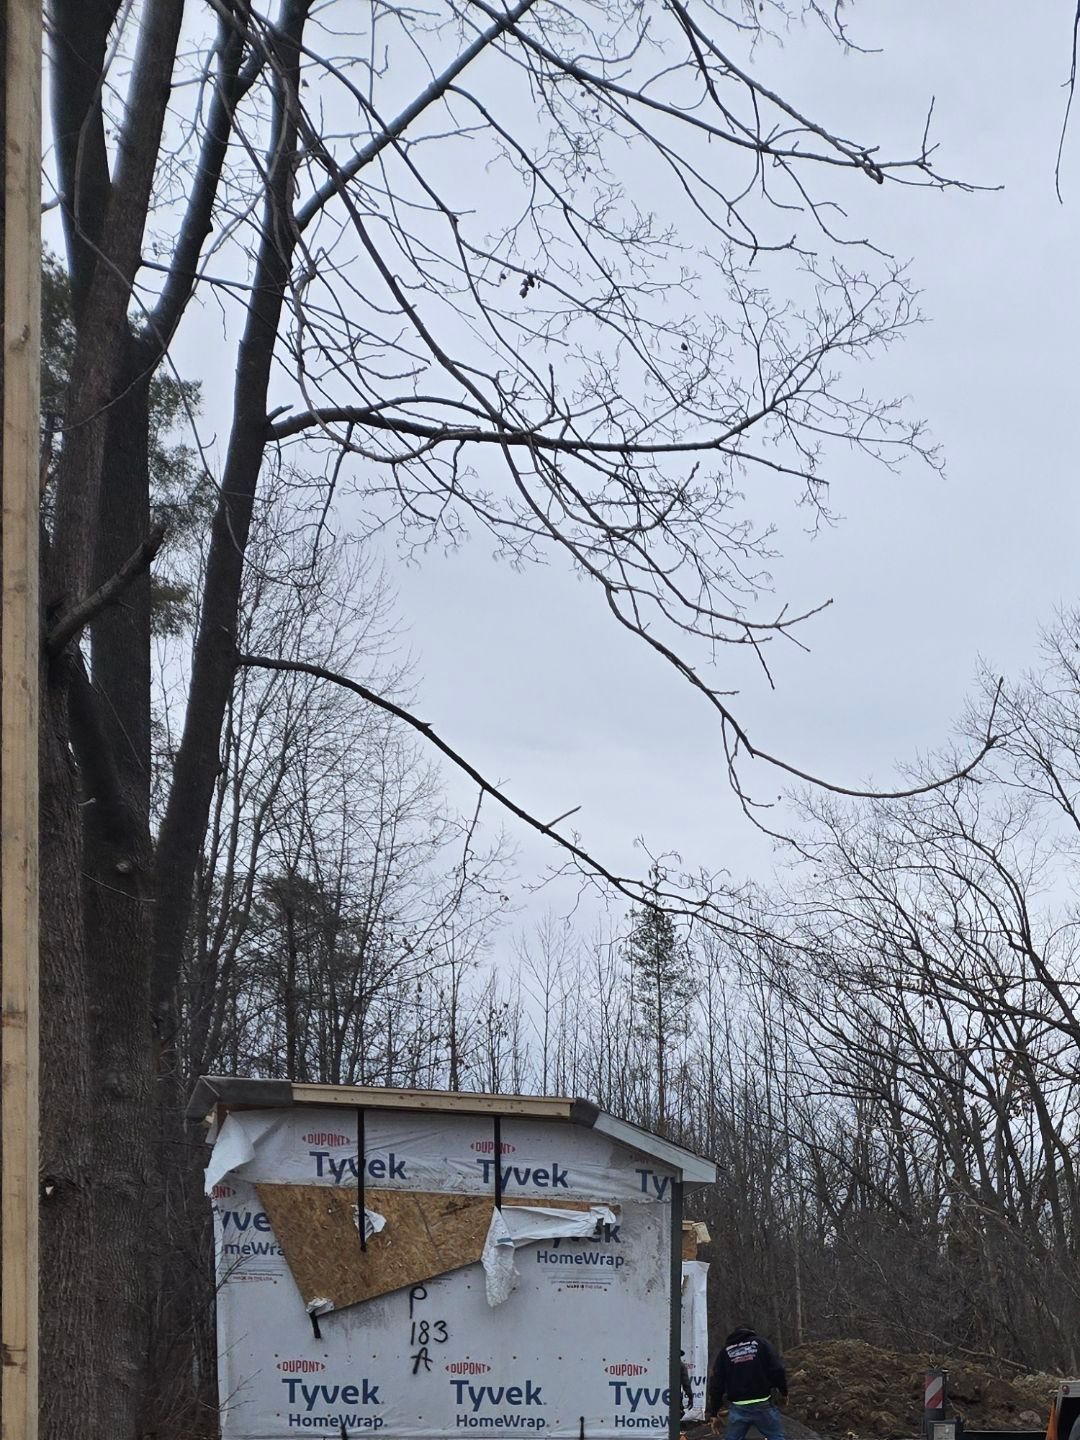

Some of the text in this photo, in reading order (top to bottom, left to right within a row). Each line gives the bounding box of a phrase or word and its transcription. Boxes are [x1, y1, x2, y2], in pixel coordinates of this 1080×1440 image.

[307, 1132, 347, 1147] DUPONT
[475, 1141, 512, 1155] DUPNT
[309, 1151, 407, 1184] Tyvek
[536, 1250, 624, 1268] HomeWrap
[409, 1286, 428, 1319] P
[410, 1320, 448, 1346] 183
[282, 1360, 321, 1373] DUPONT
[410, 1346, 433, 1375] A
[450, 1362, 487, 1375] DUPONT
[609, 1363, 643, 1377] DUPONT
[281, 1378, 381, 1411] Tyvek
[449, 1379, 543, 1412] Tyvek
[288, 1413, 384, 1431] HomeWrap
[456, 1414, 546, 1431] HomeWrap
